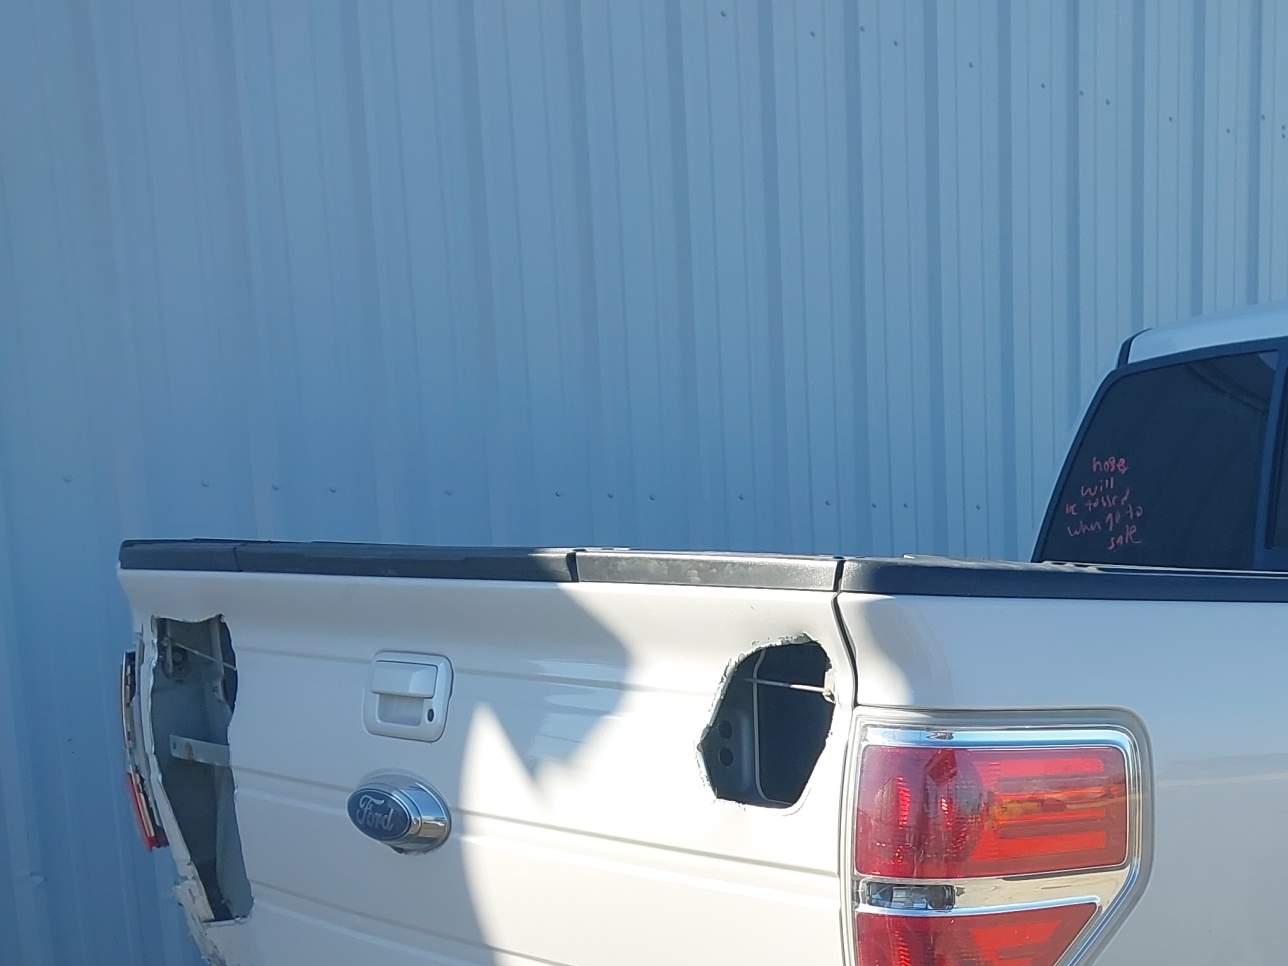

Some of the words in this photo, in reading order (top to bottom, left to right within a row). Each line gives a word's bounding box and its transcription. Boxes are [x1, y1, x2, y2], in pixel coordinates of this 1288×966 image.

[1081, 477, 1114, 496] will
[1126, 504, 1144, 519] to
[356, 794, 394, 831] Ford
